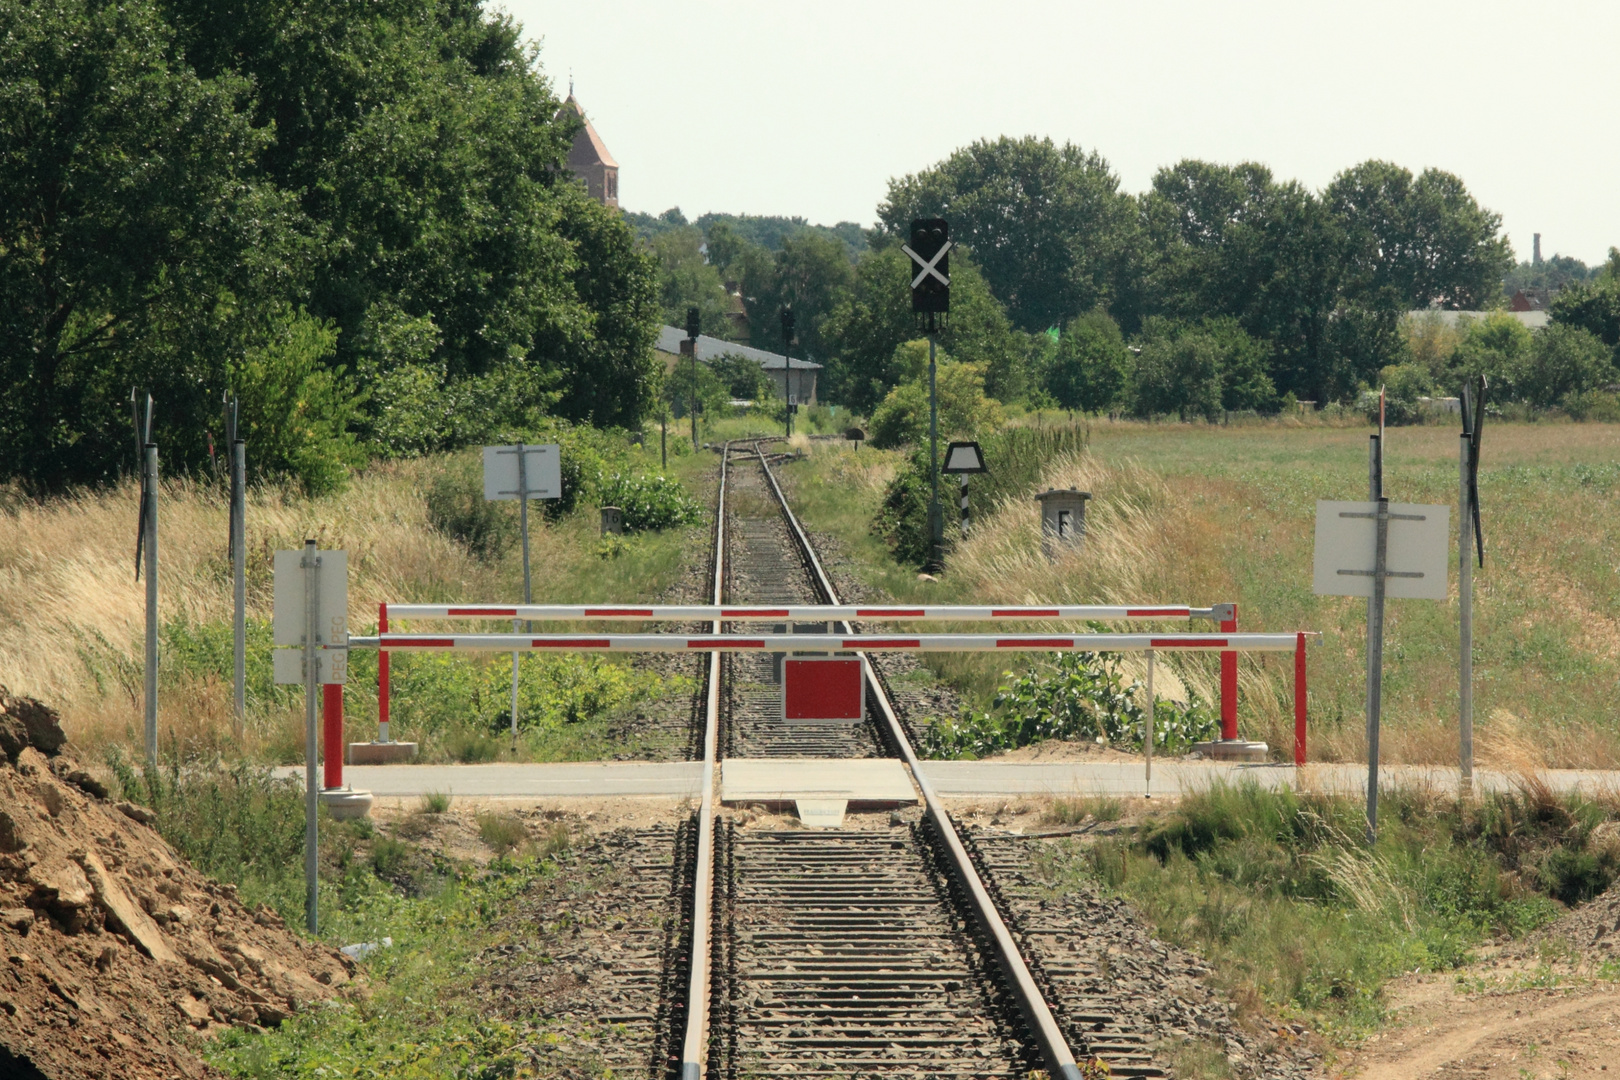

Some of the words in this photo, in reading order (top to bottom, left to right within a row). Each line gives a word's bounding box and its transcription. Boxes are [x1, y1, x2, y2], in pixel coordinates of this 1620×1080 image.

[1058, 510, 1070, 537] F
[331, 616, 345, 644] PEG
[332, 653, 345, 681] PEG
